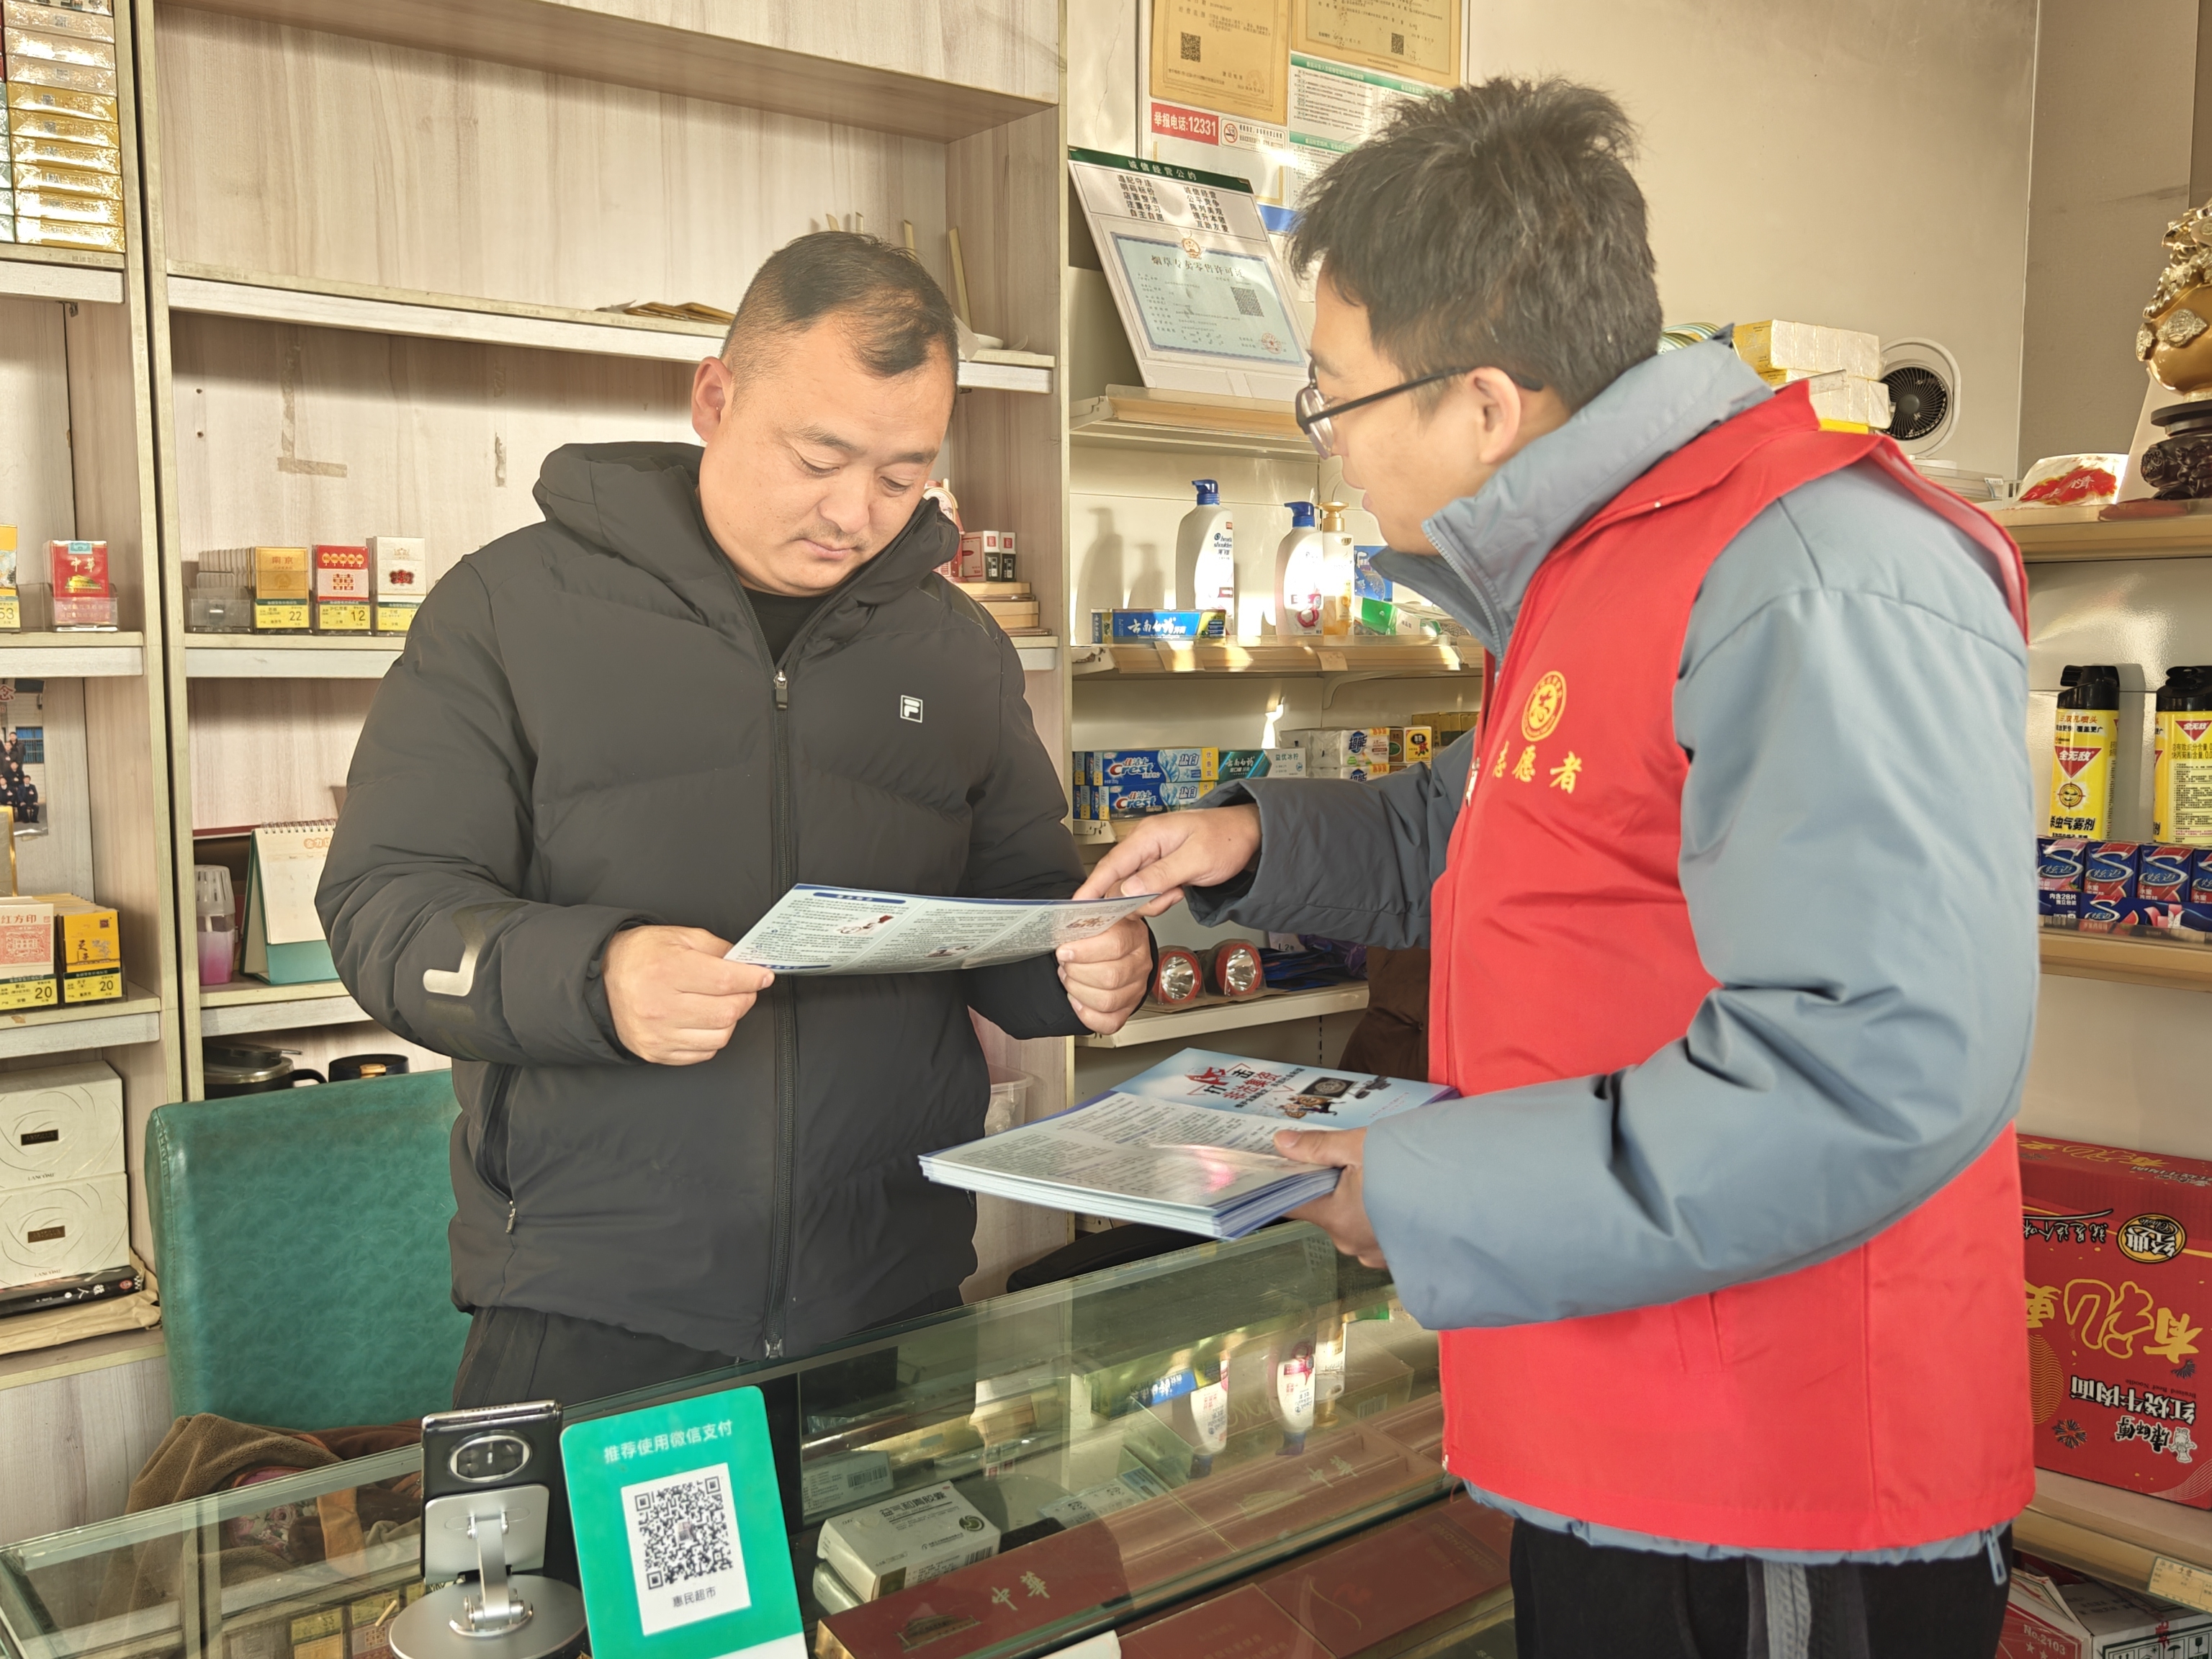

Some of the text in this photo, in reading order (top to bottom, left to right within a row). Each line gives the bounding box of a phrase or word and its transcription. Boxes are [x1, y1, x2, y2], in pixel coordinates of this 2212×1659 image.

[1154, 111, 1216, 137] 举报电话:12331
[1128, 160, 1197, 181] 诚信经营公约
[271, 556, 293, 565] 南京
[289, 611, 302, 621] 22
[351, 610, 366, 621] 12
[2183, 722, 2208, 731] 全无敌
[1124, 757, 1150, 766] 佳洁士
[1179, 753, 1200, 767] 盐白
[2059, 750, 2092, 762] 全无敌
[1110, 763, 1154, 776] Crest
[1129, 791, 1152, 800] 佳洁士
[1179, 786, 1197, 800] 盐白
[1116, 796, 1157, 809] Crest
[2045, 865, 2072, 874] 炫迈
[2093, 869, 2121, 878] 炫迈
[2146, 873, 2175, 882] 炫迈
[1, 914, 37, 924] 红方印
[99, 980, 114, 992] 20
[35, 986, 53, 999] 20
[1223, 1071, 1282, 1100] 非法集资
[2126, 1225, 2177, 1258] 经典
[2125, 1378, 2149, 1388] Noodle
[2170, 1388, 2196, 1398] Braised
[2069, 1375, 2196, 1426] 红烧牛肉面
[603, 1419, 732, 1464] 推荐使用微信支付
[672, 1586, 716, 1608] 惠民超市
[2023, 1624, 2066, 1655] No.2103
